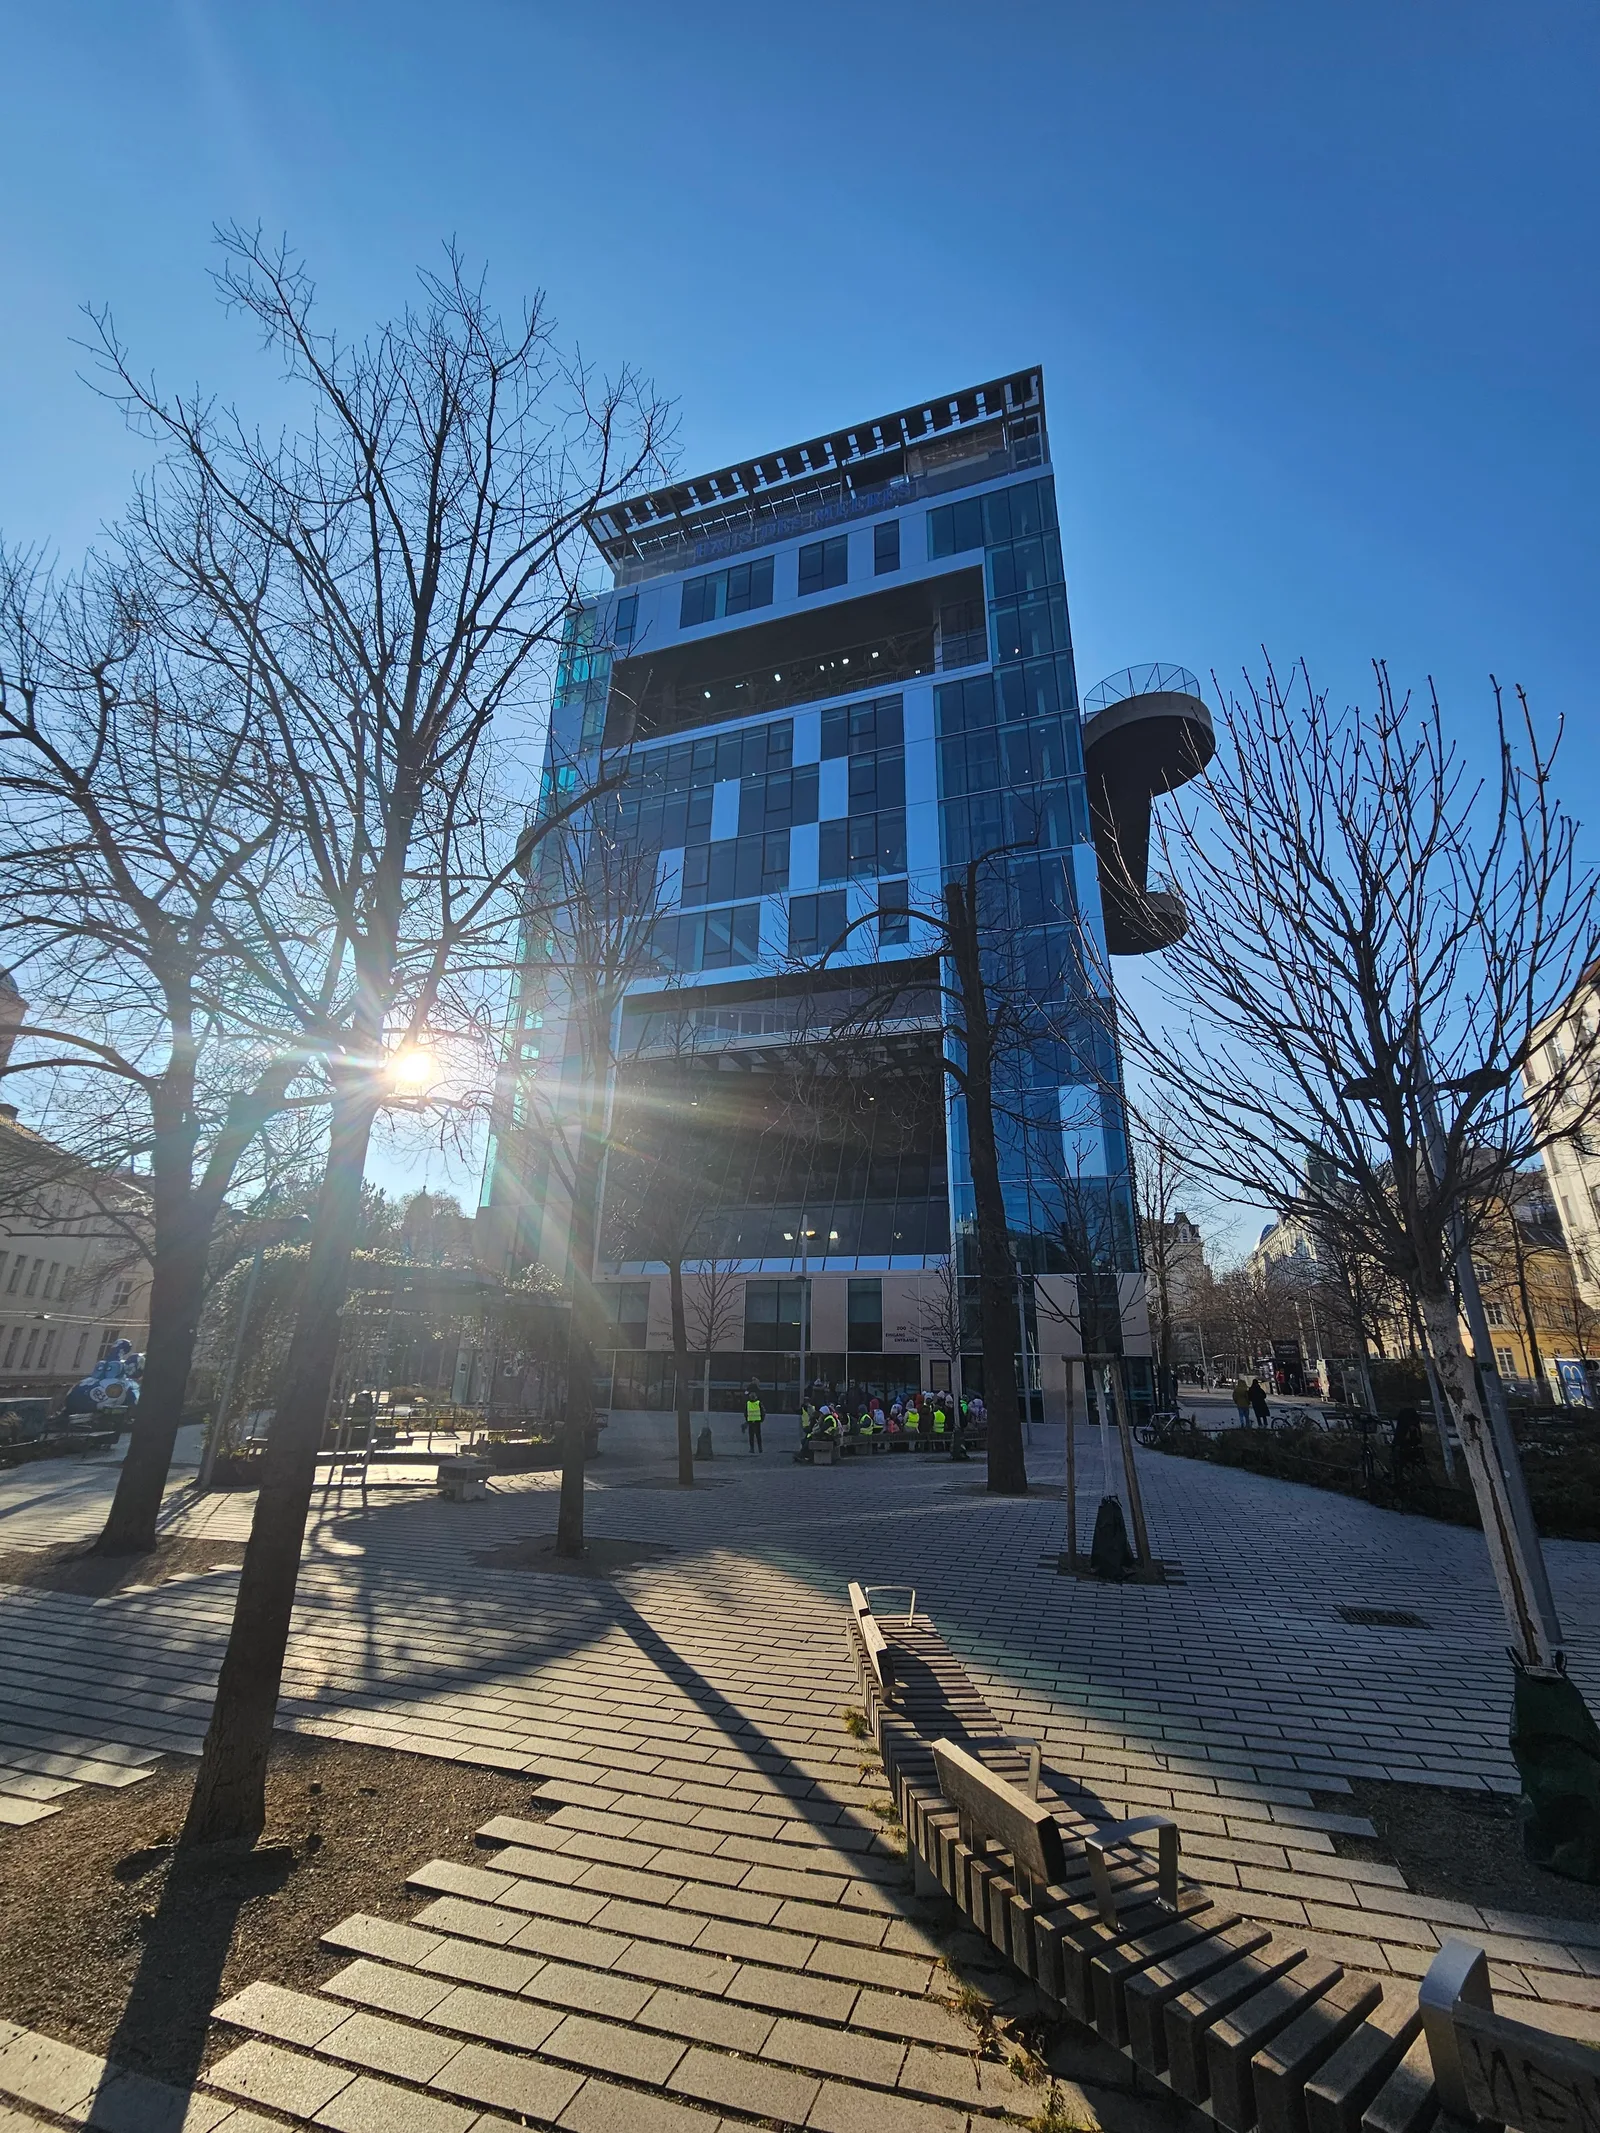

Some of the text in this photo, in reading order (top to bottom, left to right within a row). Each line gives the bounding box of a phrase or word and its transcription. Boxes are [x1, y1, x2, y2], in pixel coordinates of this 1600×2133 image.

[695, 483, 911, 557] HAUS DES MEERES
